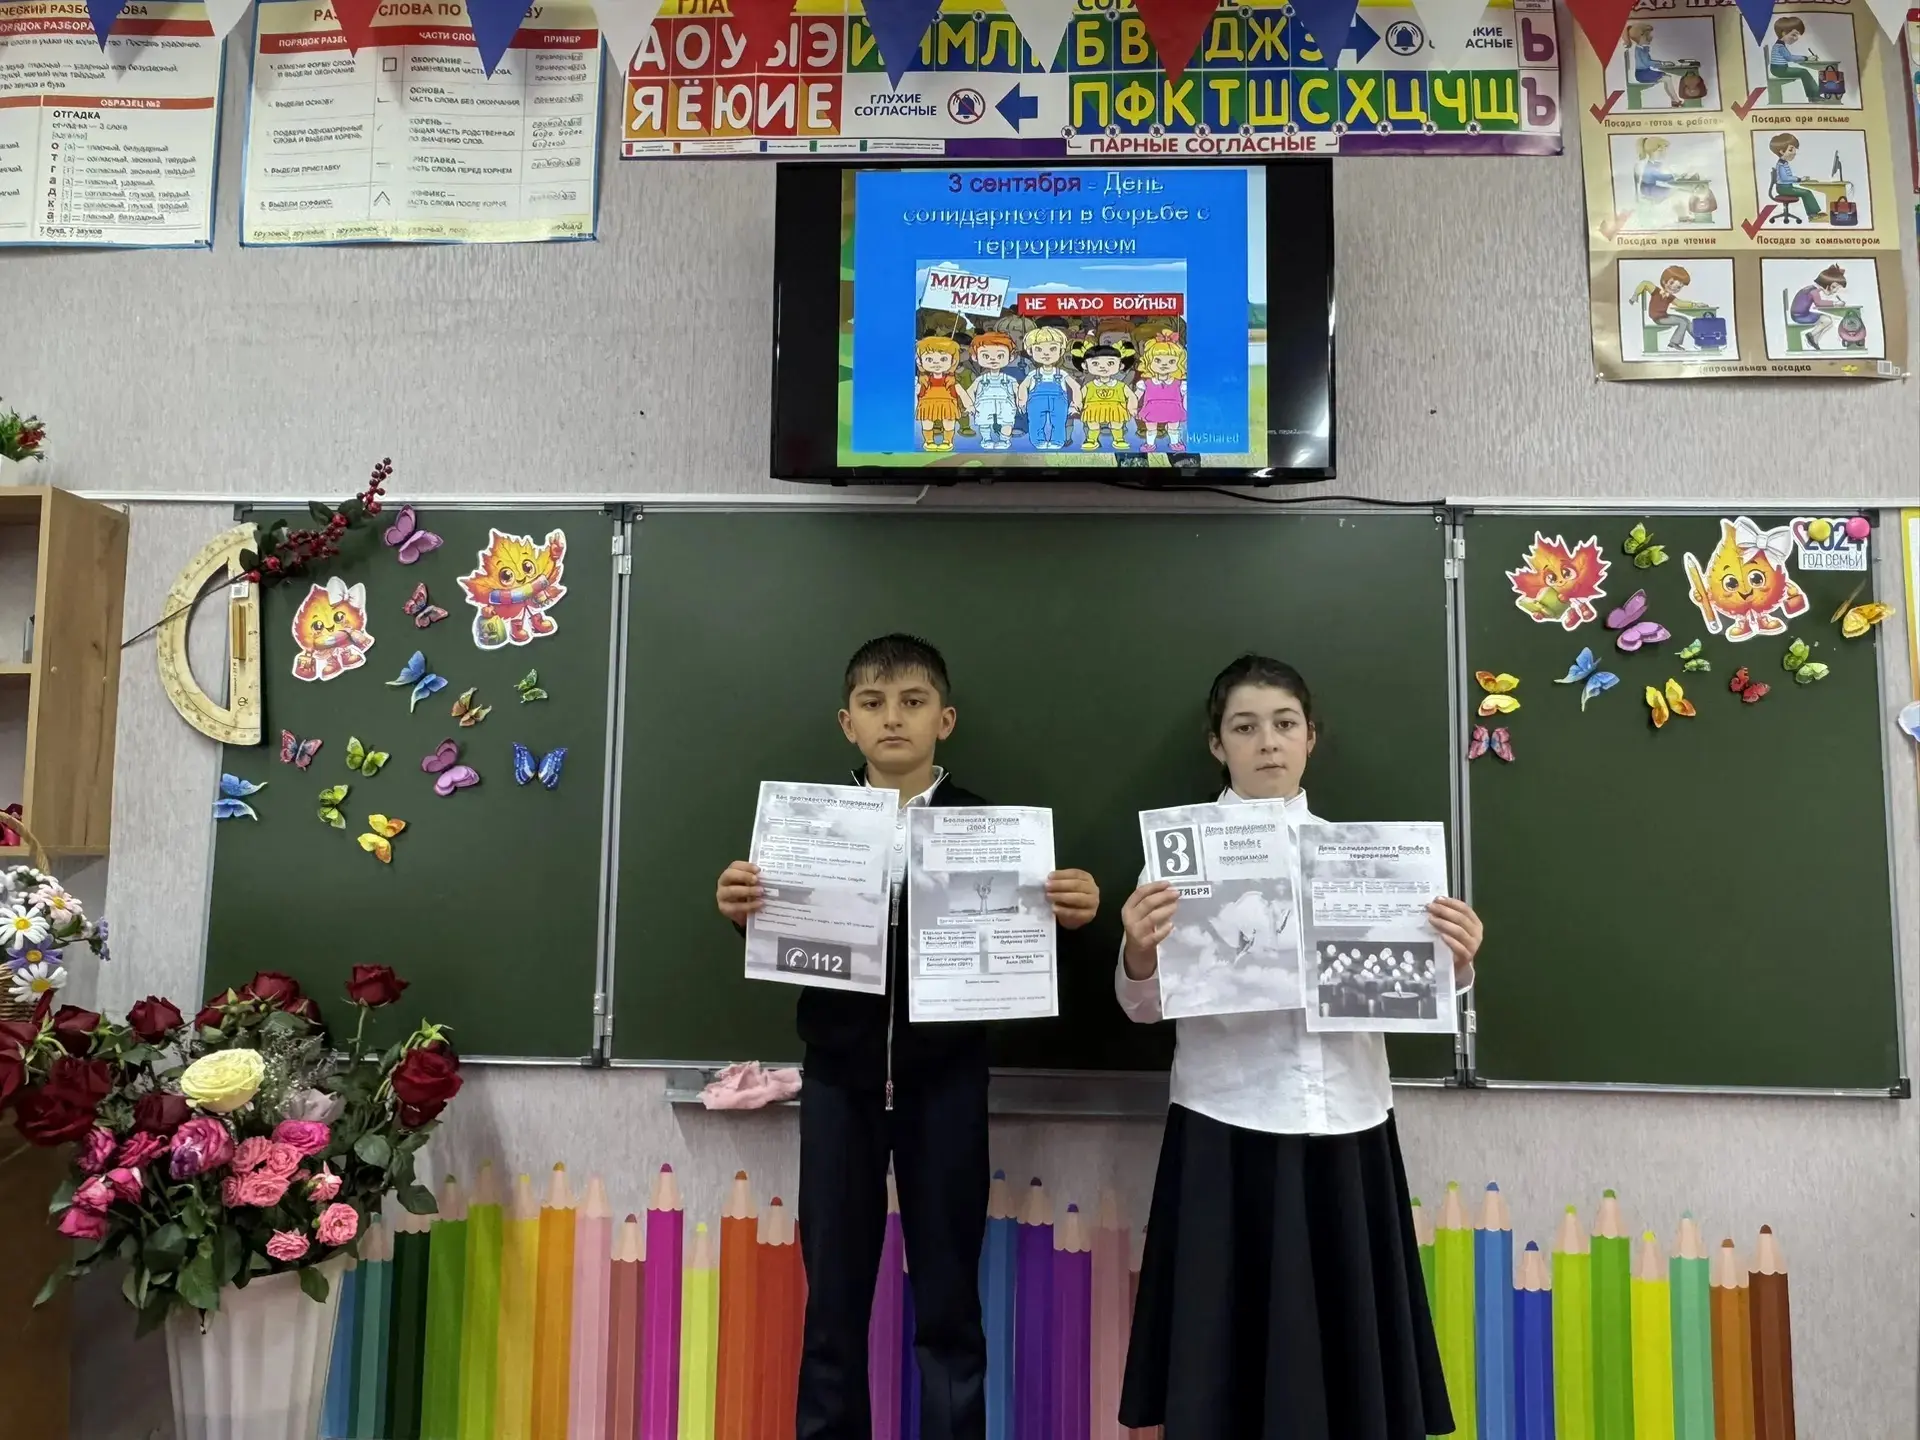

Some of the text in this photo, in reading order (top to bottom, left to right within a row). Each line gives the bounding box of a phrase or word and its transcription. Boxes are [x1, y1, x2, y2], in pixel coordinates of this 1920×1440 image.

[379, 4, 433, 16] СЛОВА
[438, 4, 461, 16] ПО
[419, 31, 450, 40] ЧАСТИ
[1473, 27, 1503, 37] КИЕ
[279, 38, 320, 47] ПОРЯДОК
[543, 36, 581, 44] ПРИМЕР
[870, 93, 921, 104] ГЛУХИЕ
[53, 110, 101, 120] ОТГАДКА
[854, 106, 937, 117] СОГЛАСНЫЕ
[1090, 136, 1317, 153] ПАРНЫЕ СОГЛАСНЫЕ
[948, 172, 1165, 196] 3 сентября День
[903, 202, 1211, 228] солидарности в борьбе с
[974, 237, 1137, 259] терроризмом
[930, 272, 990, 291] МИРУ
[951, 290, 1002, 310] МИР!
[1025, 293, 1177, 311] НЕ НАДО ВОЙНЫ!
[1803, 553, 1823, 567] ГОД
[1163, 831, 1190, 874] 3
[1177, 887, 1210, 896] ТЯБРЯ
[811, 951, 843, 973] 112
